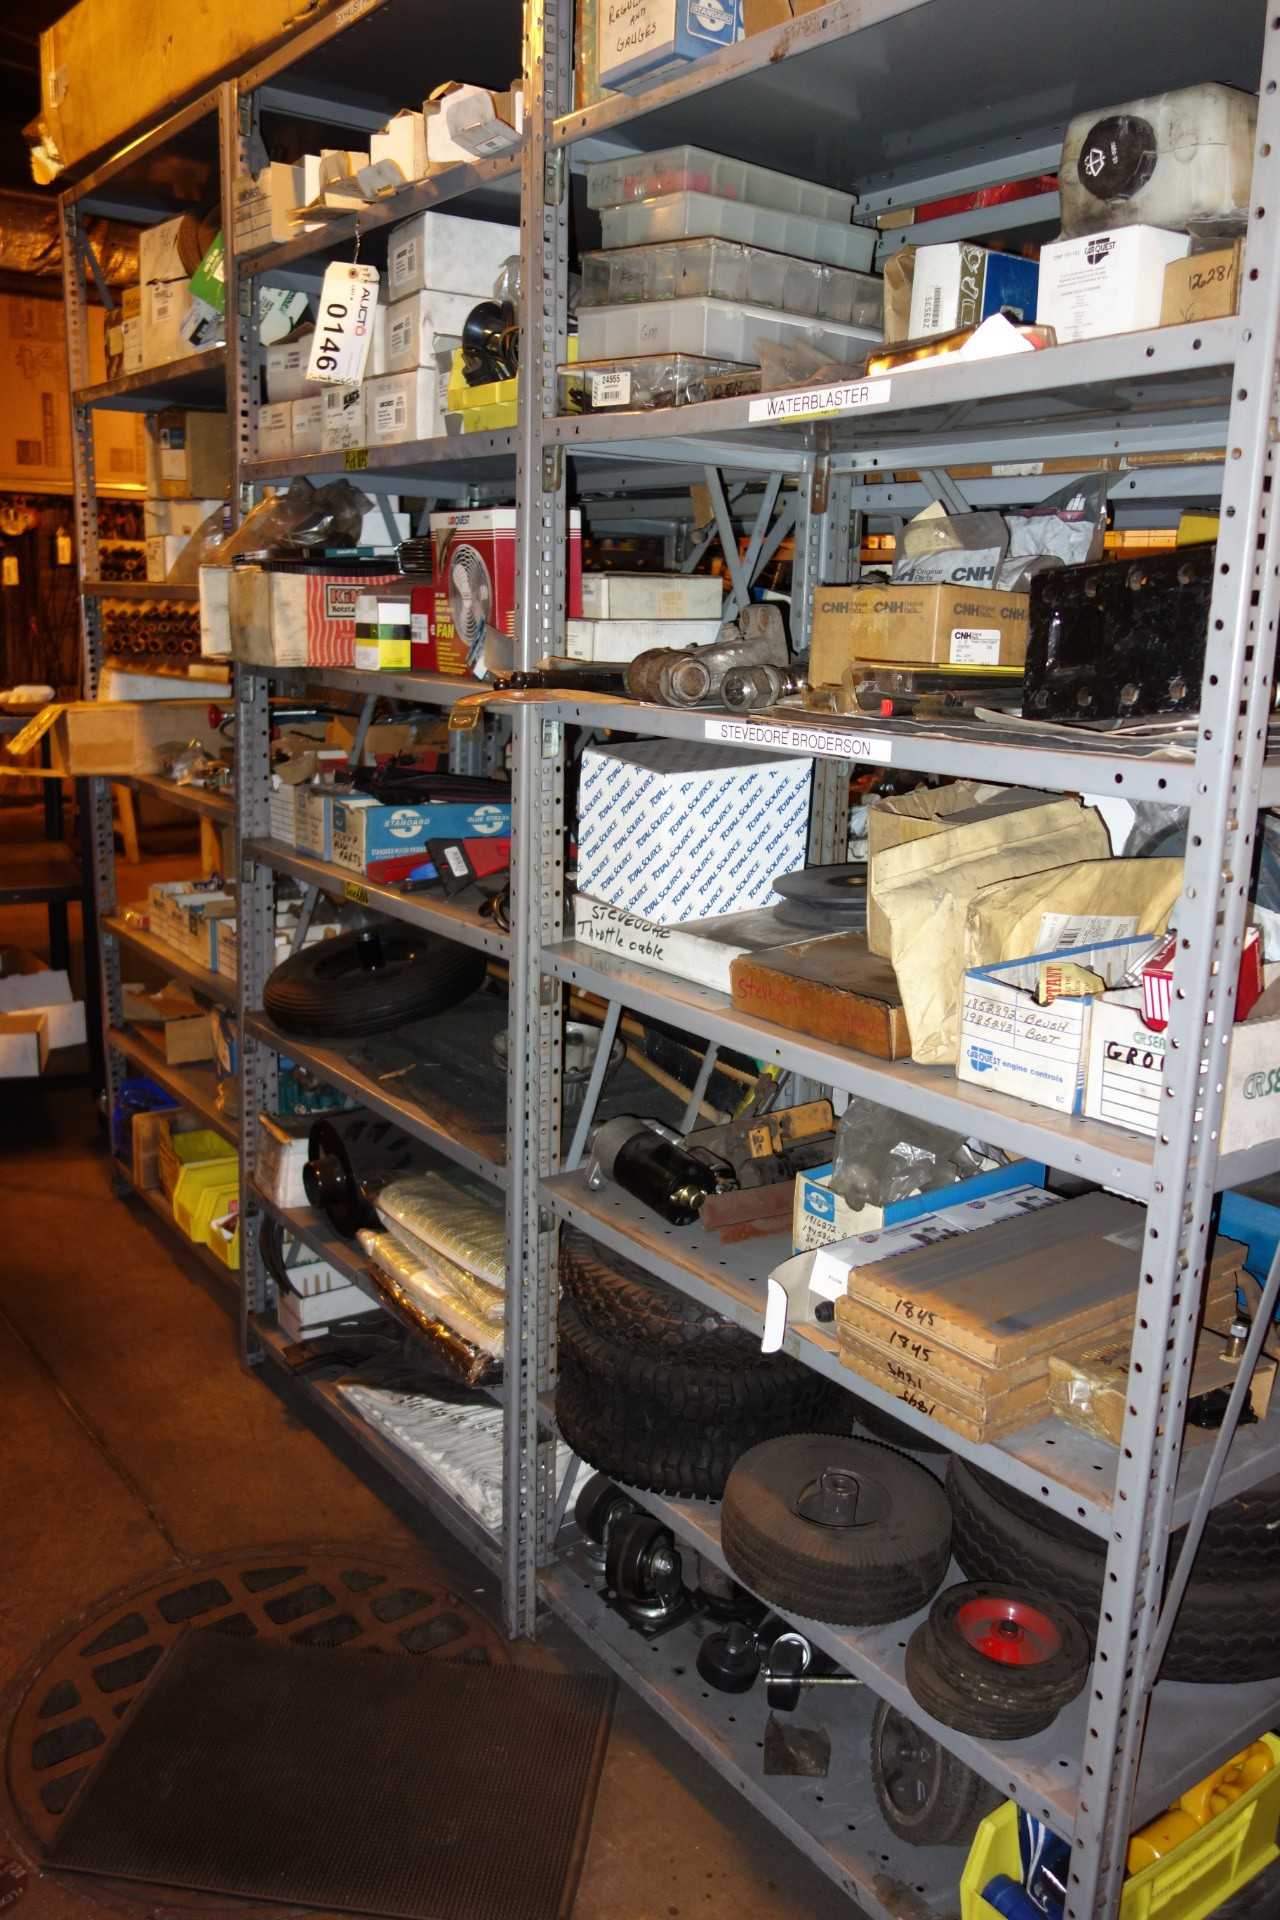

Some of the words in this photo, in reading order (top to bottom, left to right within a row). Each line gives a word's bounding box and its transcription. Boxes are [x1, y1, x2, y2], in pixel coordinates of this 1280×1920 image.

[316, 303, 348, 371] 0146
[767, 386, 869, 416] WATERBLASTER
[951, 566, 995, 582] CNH
[822, 601, 849, 614] CNH
[873, 601, 904, 614] CNH
[953, 602, 980, 617] CNH
[1000, 606, 1025, 620] CNH
[436, 623, 454, 639] FAN
[954, 631, 972, 640] CNH
[720, 724, 789, 745] STEVEDORE
[792, 732, 871, 756] BRODERSON
[384, 815, 431, 828] STANDARD
[629, 941, 664, 961] cable
[895, 1299, 938, 1326] 1845
[889, 1331, 931, 1362] 1845
